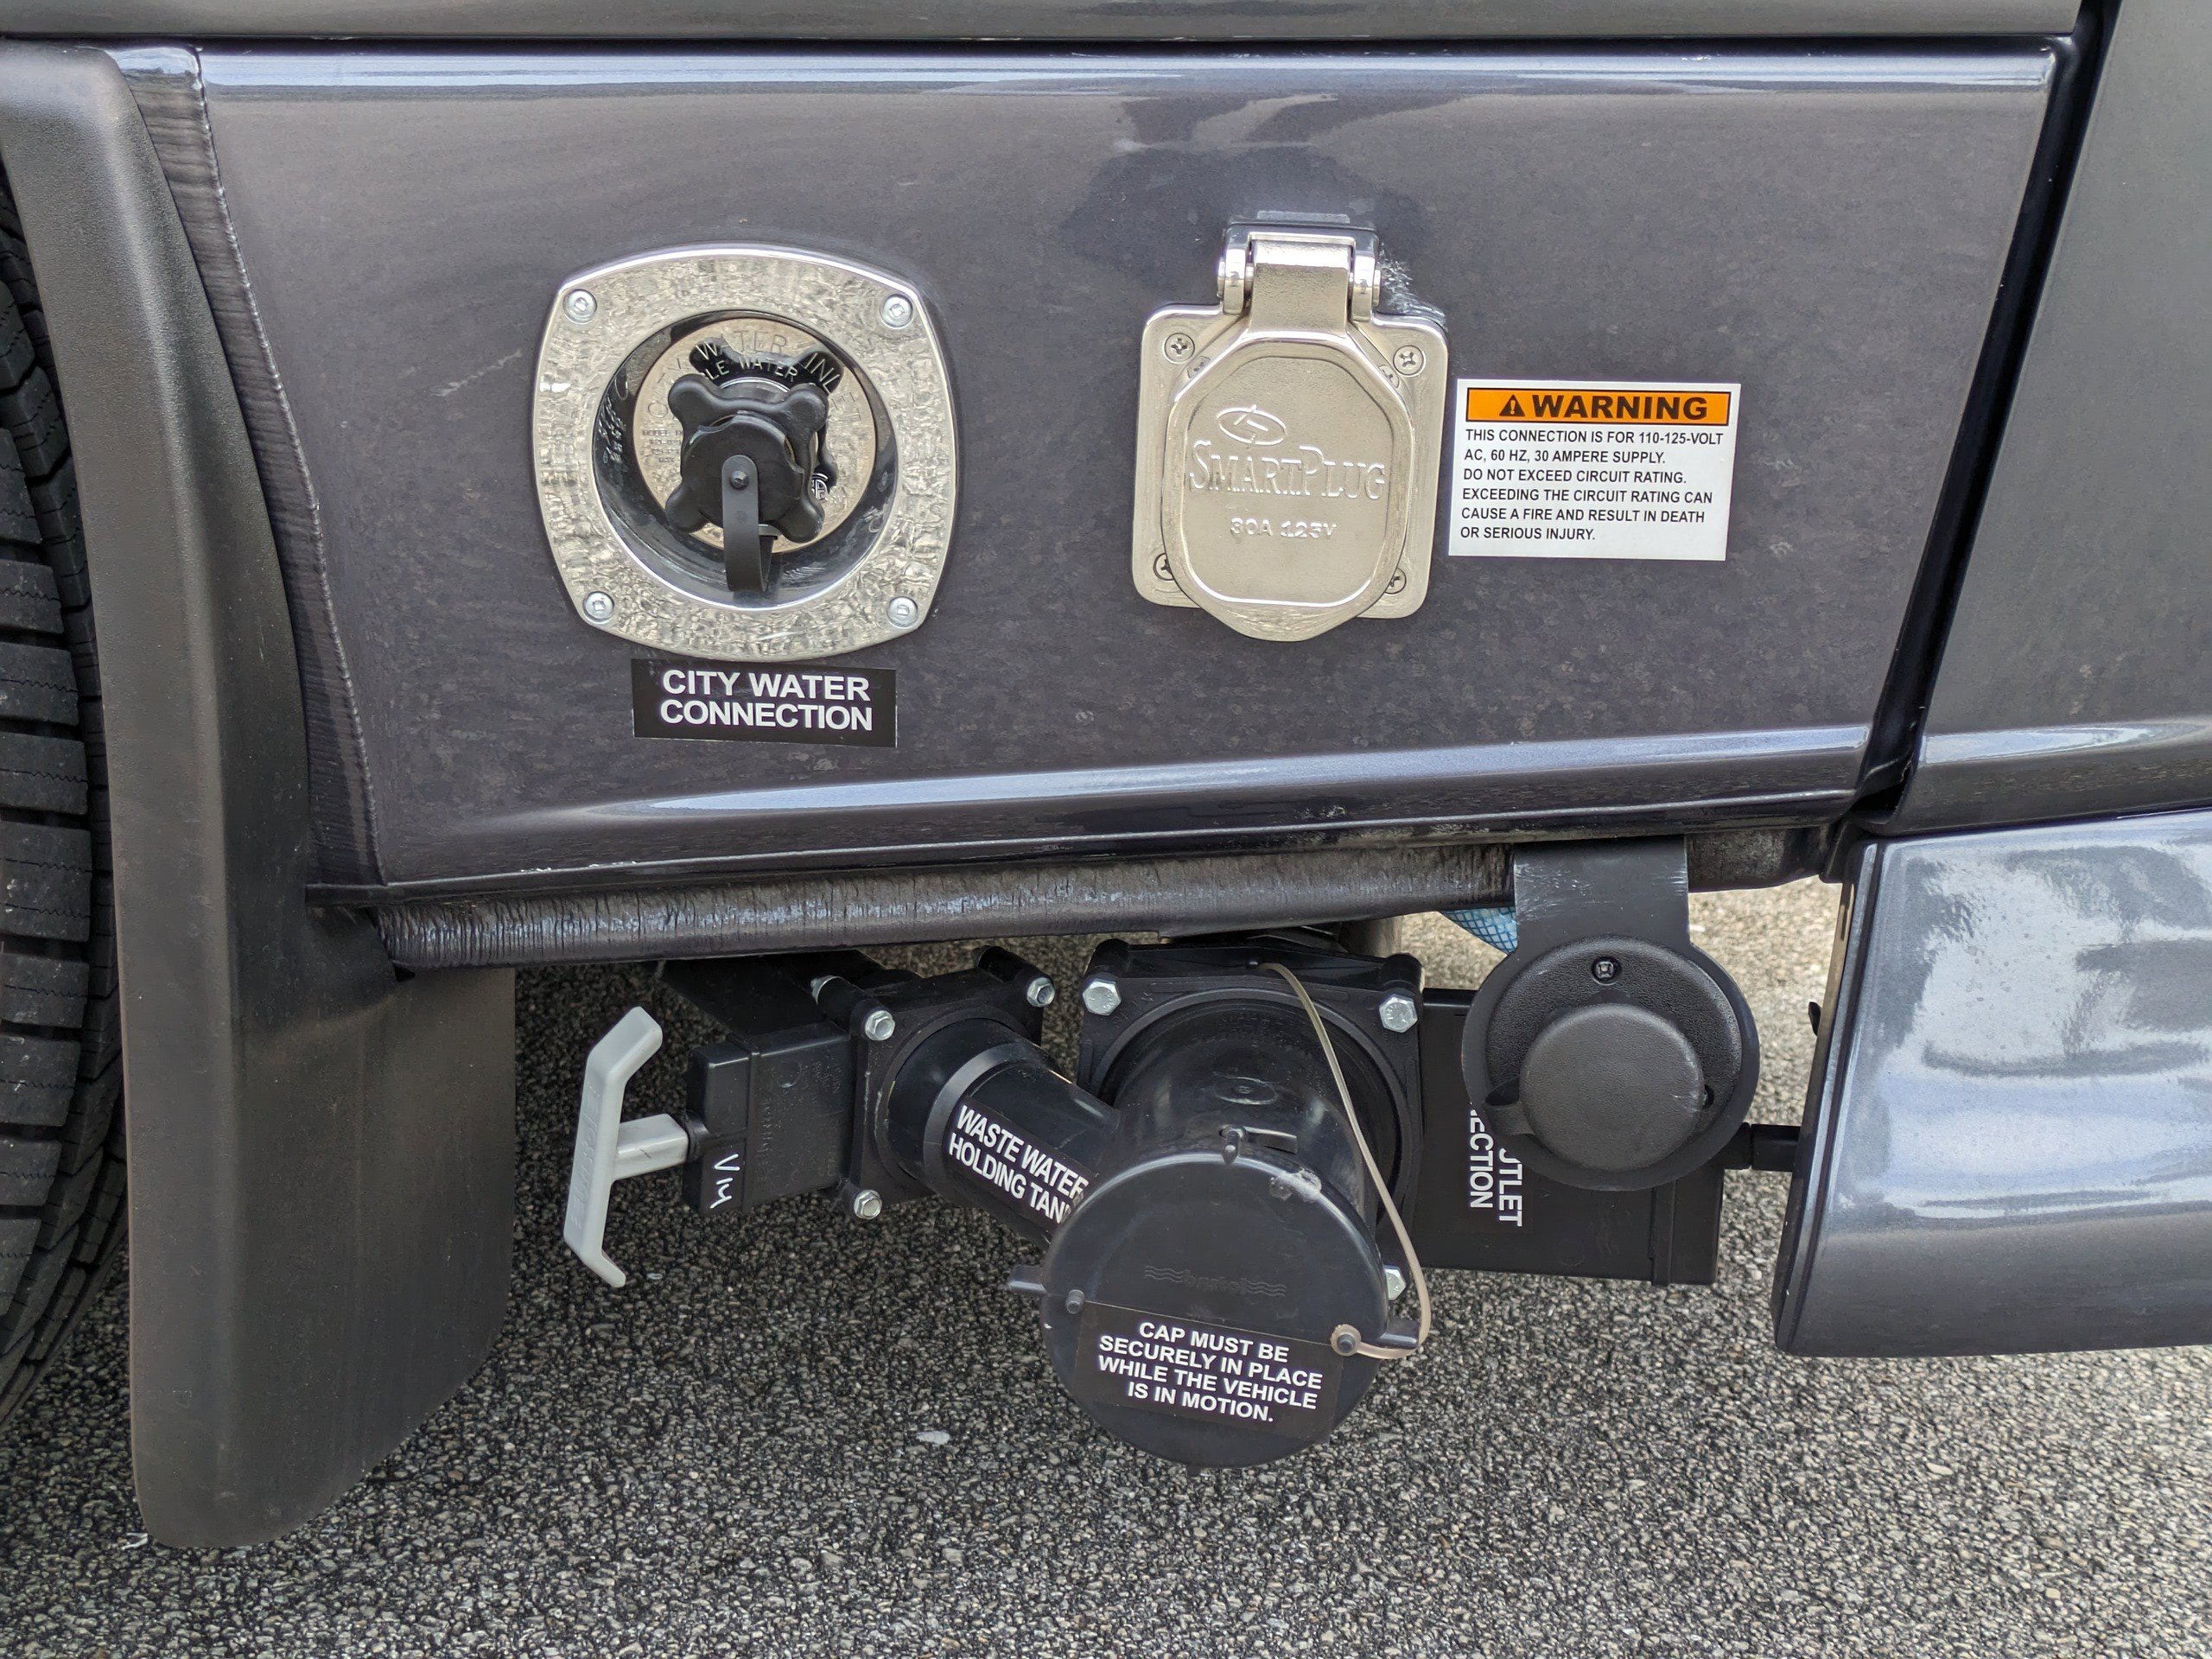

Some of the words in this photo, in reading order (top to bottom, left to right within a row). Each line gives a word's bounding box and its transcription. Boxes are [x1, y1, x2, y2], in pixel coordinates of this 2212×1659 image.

[738, 357, 798, 383] WATER
[1532, 394, 1708, 421] WARNING
[1465, 429, 1495, 442] THIS
[1498, 429, 1587, 443] CONNECTION
[1591, 430, 1604, 443] IS
[1607, 431, 1635, 444] FOR
[1638, 432, 1724, 446] 110-125-VOLT
[1464, 448, 1487, 463] AC,
[1491, 449, 1506, 462] 60
[1509, 449, 1530, 464] HZ,
[1534, 449, 1549, 462] 30
[1552, 450, 1608, 463] AMPERE
[1612, 451, 1666, 464] SUPPLY.
[1463, 468, 1484, 480] DO
[1486, 468, 1515, 481] NOT
[1518, 469, 1573, 482] EXCEED
[1576, 470, 1630, 483] CIRCUIT
[1633, 471, 1688, 484] RATING.
[1462, 488, 1540, 501] EXCEEDING
[1544, 489, 1570, 502] THE
[1573, 489, 1627, 503] CIRCUIT
[1630, 490, 1681, 504] RATING
[1684, 491, 1713, 504] CAN
[1231, 517, 1273, 537] 30A
[1281, 520, 1338, 538] 125V
[1460, 507, 1507, 520] CAUSE
[1510, 508, 1520, 520] A
[1523, 508, 1553, 521] FIRE
[1555, 509, 1585, 522] AND
[1588, 510, 1641, 523] RESULT
[1643, 511, 1657, 523] IN
[1661, 511, 1706, 524] DEATH
[1460, 526, 1480, 539] OR
[1483, 527, 1542, 540] SERIOUS
[1546, 528, 1595, 541] INJURY.
[662, 669, 741, 696] CITY
[748, 672, 871, 702] WATER
[660, 698, 874, 731] CONNECTION
[957, 1104, 1024, 1163] WASTE
[1021, 1144, 1090, 1201] WATER
[1470, 1109, 1494, 1208] ECTION
[949, 1132, 1027, 1200] HOLDING
[1029, 1181, 1071, 1224] TAN
[1498, 1147, 1523, 1227] UTLET
[1138, 1321, 1185, 1343] CAP
[1190, 1331, 1253, 1357] MUST
[1258, 1343, 1290, 1363] BE
[1099, 1335, 1217, 1370] SECURELY
[1220, 1356, 1243, 1376] IN
[1248, 1362, 1324, 1389] PLACE
[1098, 1355, 1168, 1383] WHILE
[1174, 1369, 1218, 1392] THE
[1223, 1377, 1319, 1410] VEHICLE
[1128, 1382, 1149, 1399] IS
[1154, 1386, 1177, 1405] IN
[1181, 1391, 1274, 1422] MOTION.
